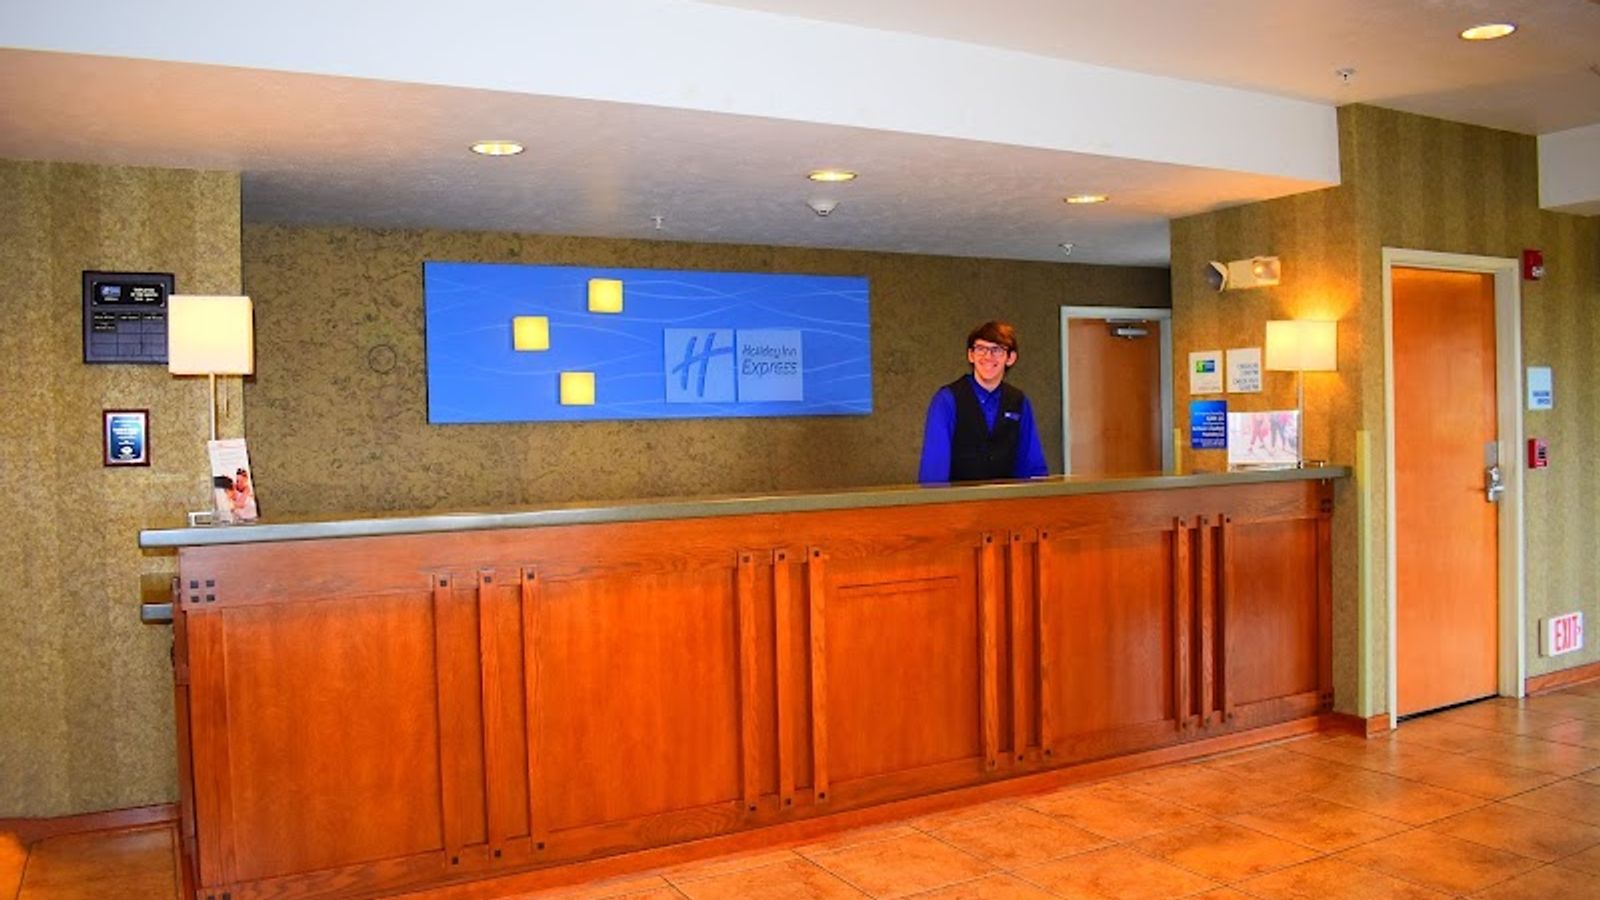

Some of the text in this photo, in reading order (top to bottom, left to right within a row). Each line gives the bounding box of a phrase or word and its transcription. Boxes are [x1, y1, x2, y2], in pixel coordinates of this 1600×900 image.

[742, 344, 797, 359] Holiday Inn
[742, 359, 798, 377] Express
[1554, 615, 1577, 652] EXIT
